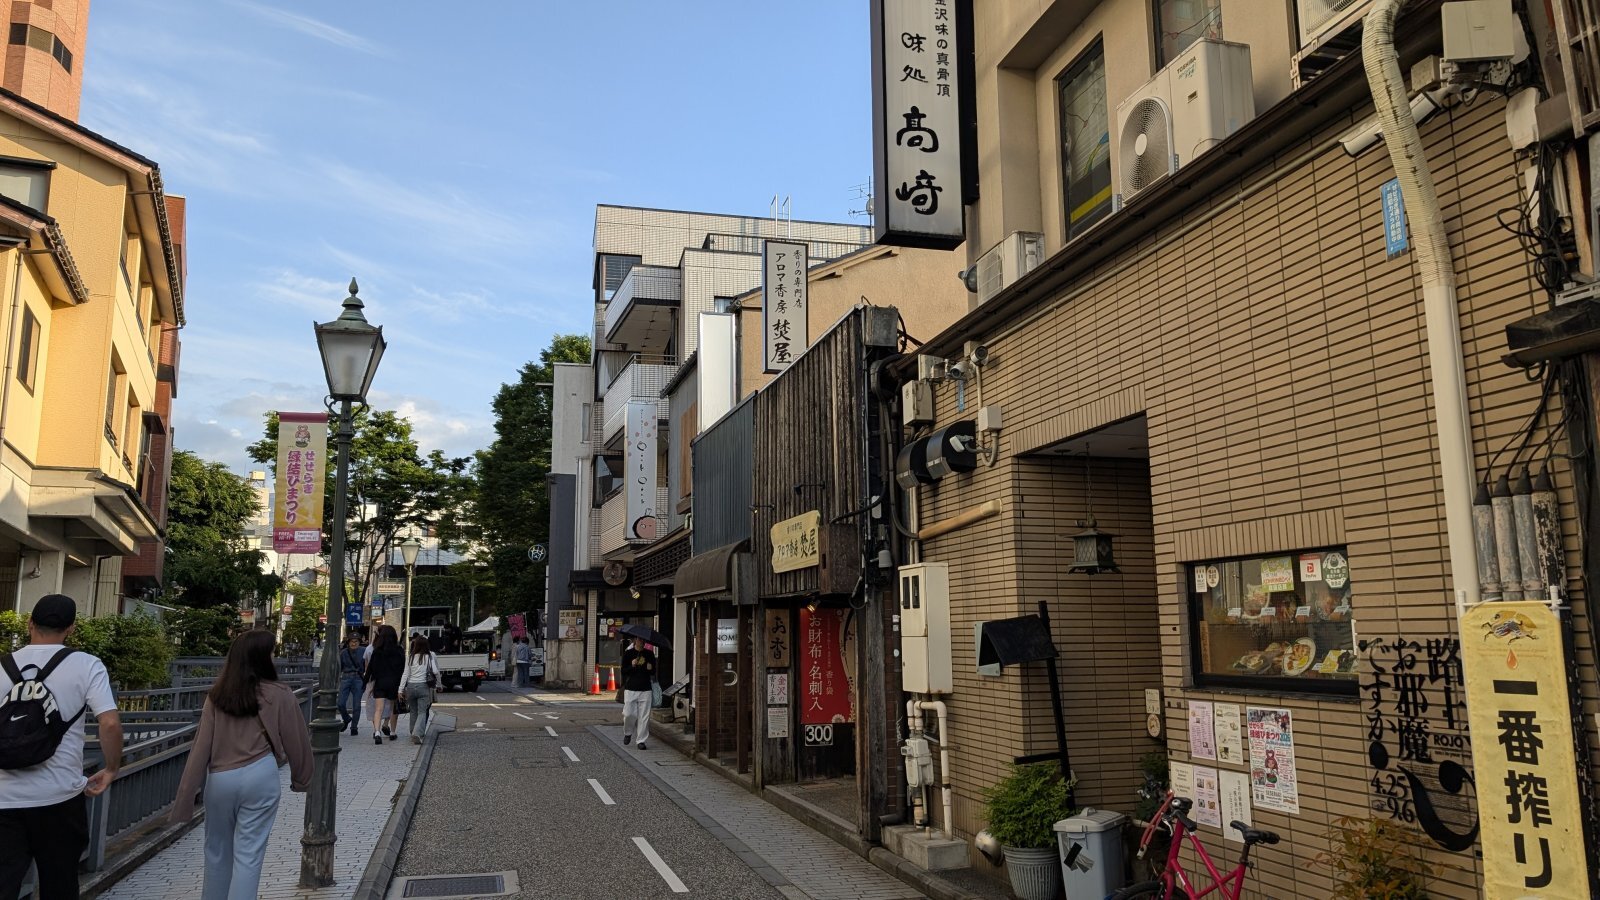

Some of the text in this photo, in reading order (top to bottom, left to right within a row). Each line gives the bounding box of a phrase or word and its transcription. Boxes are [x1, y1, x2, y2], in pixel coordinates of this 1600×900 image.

[774, 252, 788, 315] アロマ香房
[793, 249, 803, 309] 香りの専門店
[285, 450, 302, 525] 縁結びまつり
[304, 450, 316, 495] せせらぎ
[808, 615, 824, 712] お財布・名刺入
[21, 680, 48, 700] DO
[806, 725, 833, 743] 300
[1370, 770, 1409, 799] 4.25
[1493, 679, 1553, 889] 一番搾り
[1387, 797, 1416, 824] 9.6
